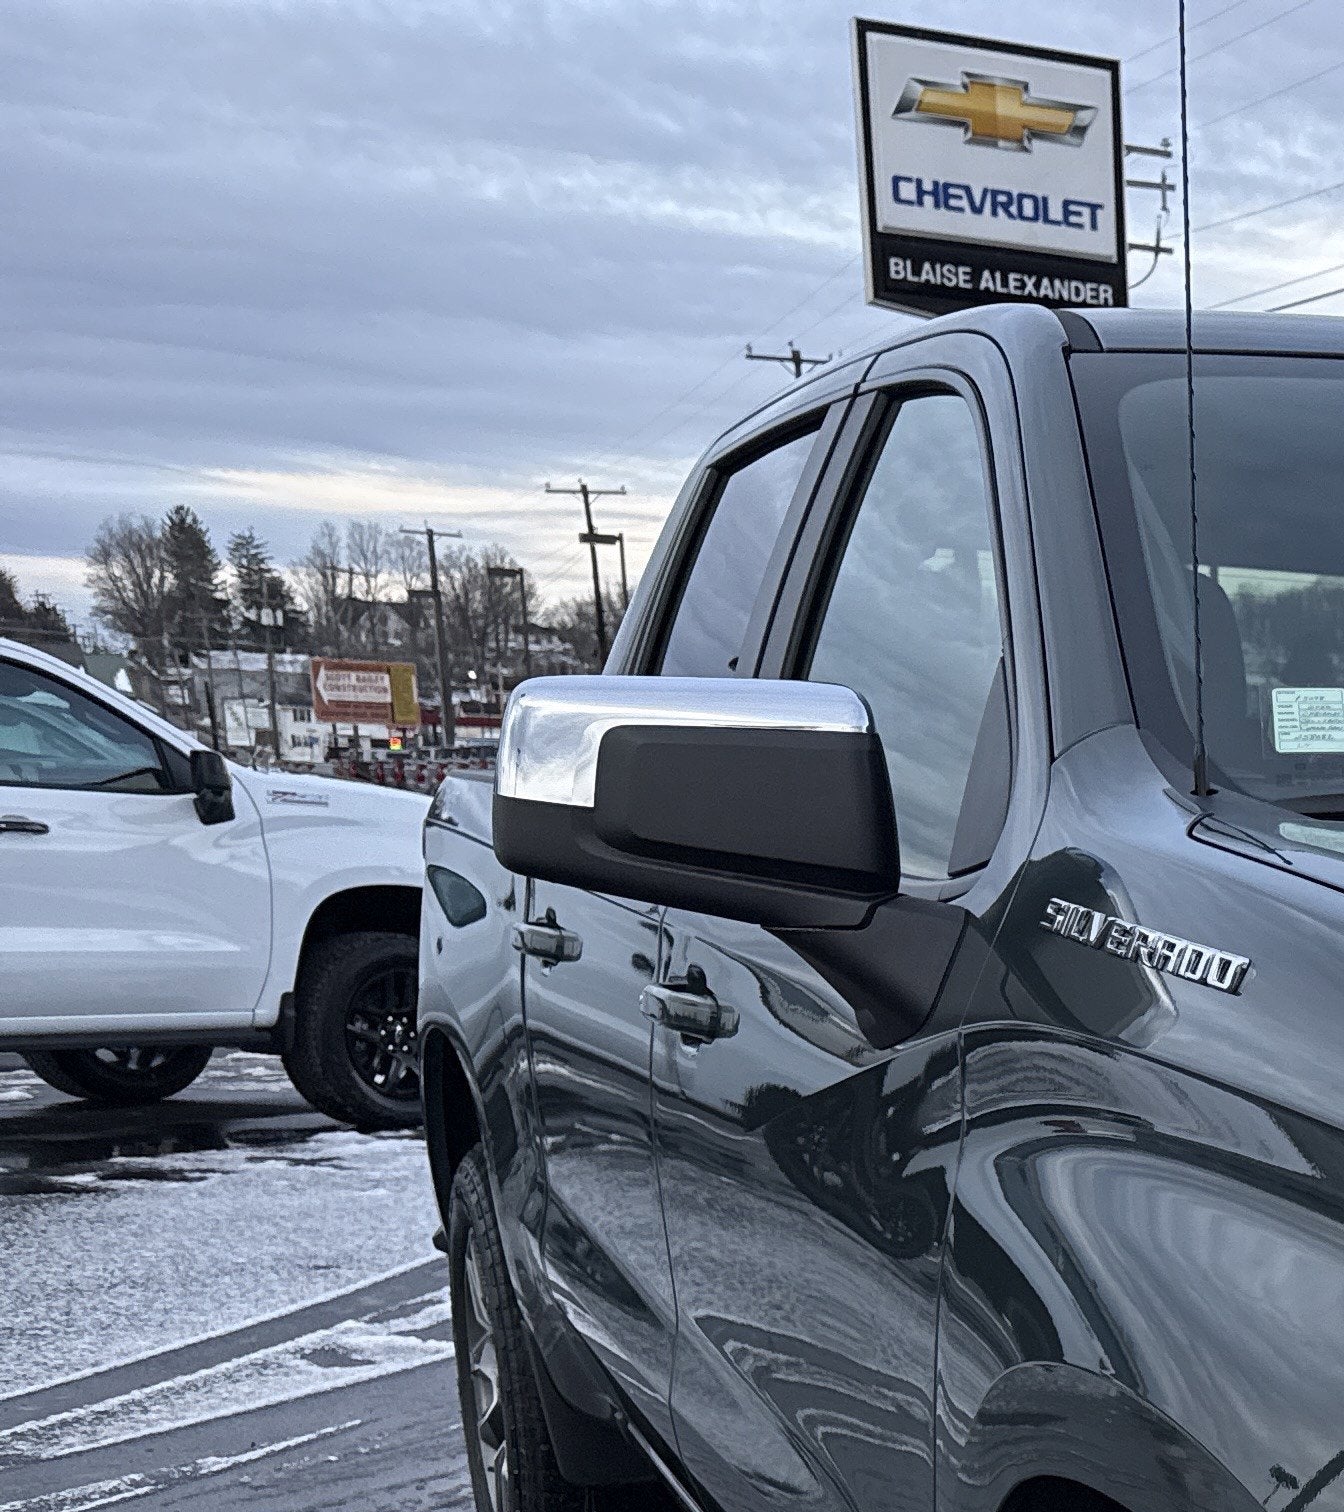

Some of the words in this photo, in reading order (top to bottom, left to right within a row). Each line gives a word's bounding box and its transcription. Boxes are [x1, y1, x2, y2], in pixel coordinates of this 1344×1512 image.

[891, 174, 1105, 232] CHEVROLET
[888, 256, 973, 290] BLAISE
[978, 269, 1114, 307] ALEXANDER
[1040, 897, 1252, 995] SILVERADO
